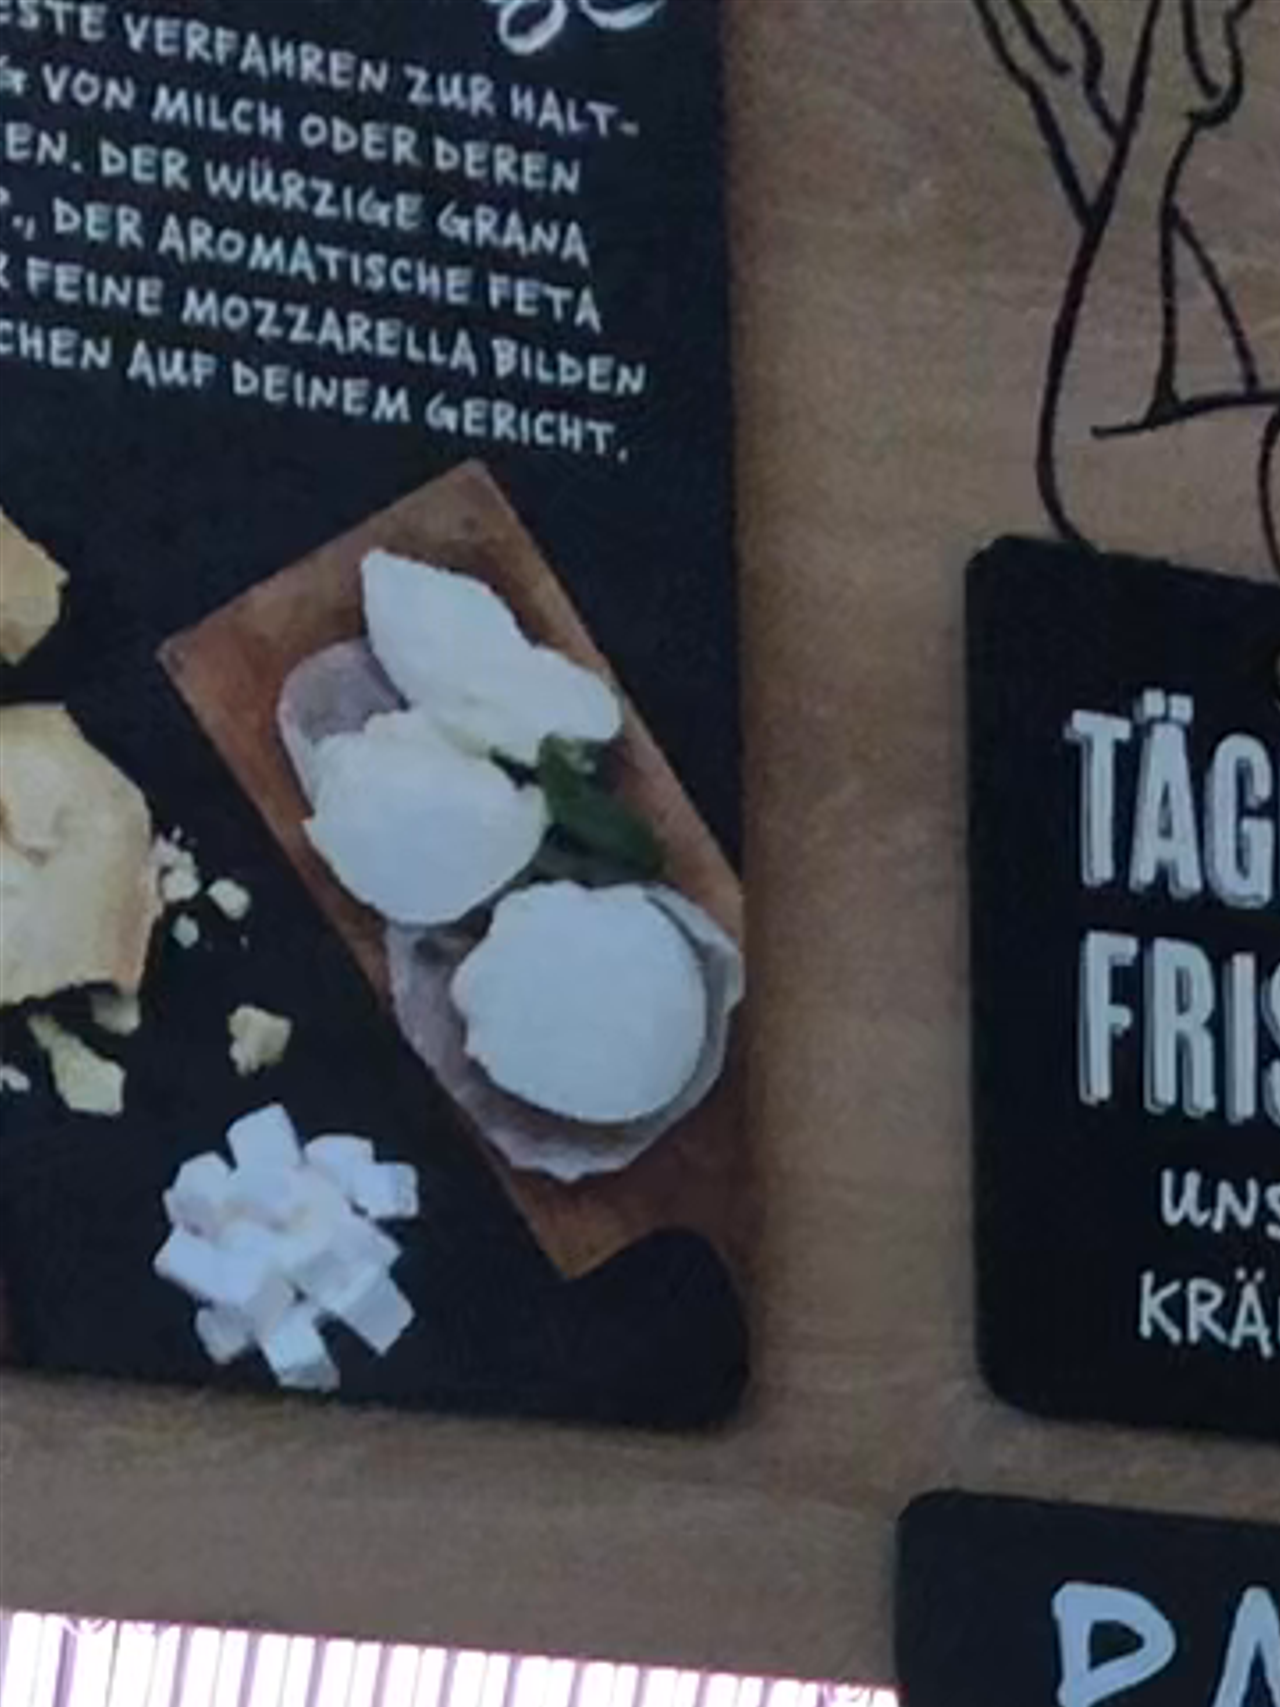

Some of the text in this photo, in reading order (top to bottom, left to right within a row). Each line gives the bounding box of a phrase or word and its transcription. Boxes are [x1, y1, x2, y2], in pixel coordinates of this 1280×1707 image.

[42, 62, 136, 112] VON
[152, 83, 284, 142] MILCH
[300, 113, 422, 167] ODER
[433, 135, 581, 196] DEREN
[122, 12, 390, 94] VERFAHREN
[403, 62, 495, 118] ZUR
[510, 83, 640, 138] HALT-
[53, 196, 145, 250] DER
[157, 212, 475, 306] AROMATISCHE
[487, 270, 603, 335] FETA
[100, 138, 191, 191] DER
[204, 157, 423, 232] WÜRZIGE
[436, 200, 591, 270] GRANA
[26, 256, 165, 318] FEINE
[181, 286, 480, 379] MOZZARELLA
[491, 338, 648, 397] BILDEN
[126, 338, 218, 390] AUF
[230, 359, 413, 425] DEINEM
